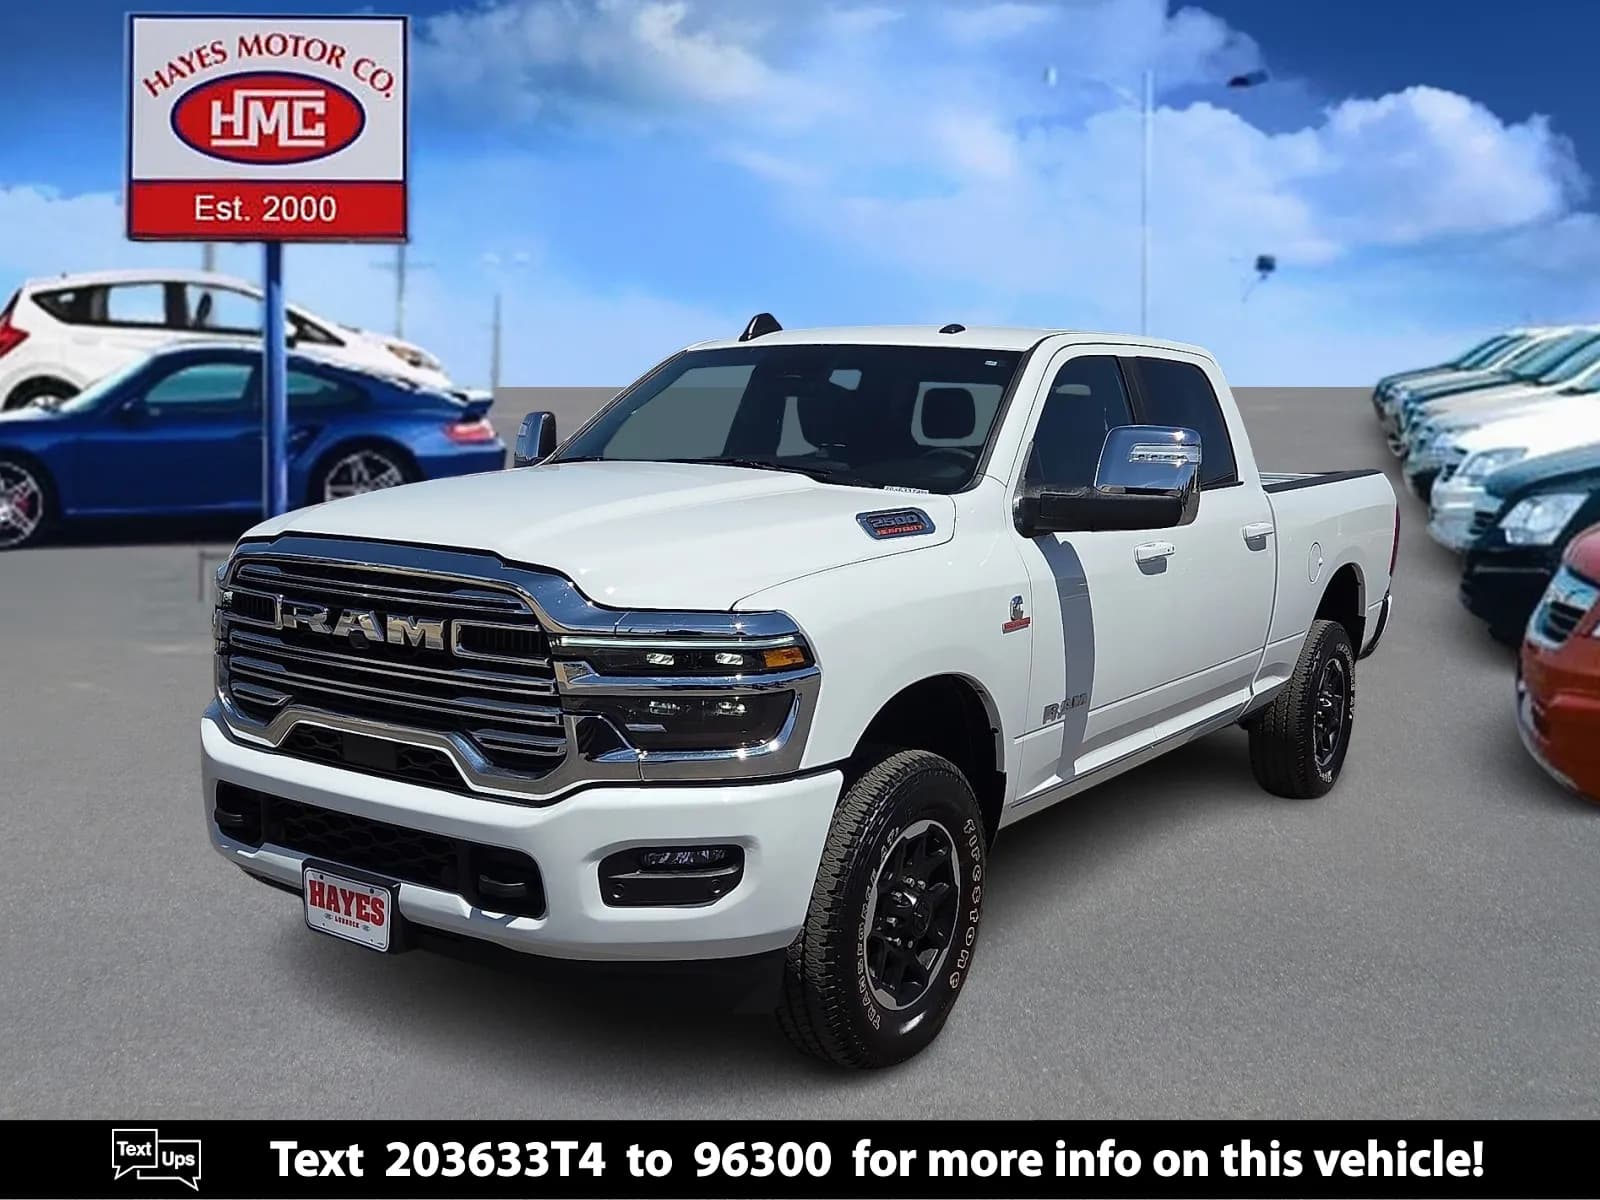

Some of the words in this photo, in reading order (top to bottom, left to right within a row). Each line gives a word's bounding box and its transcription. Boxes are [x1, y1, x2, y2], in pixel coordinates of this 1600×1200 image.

[142, 40, 227, 98] HAYES
[237, 32, 346, 69] MOTOR
[352, 57, 394, 98] CO.
[210, 89, 325, 147] HMC
[194, 194, 250, 222] Est.
[262, 195, 337, 222] 2000
[871, 514, 917, 528] 2500
[280, 599, 448, 650] RAM
[1042, 692, 1088, 725] RAM
[308, 879, 386, 927] HAYES
